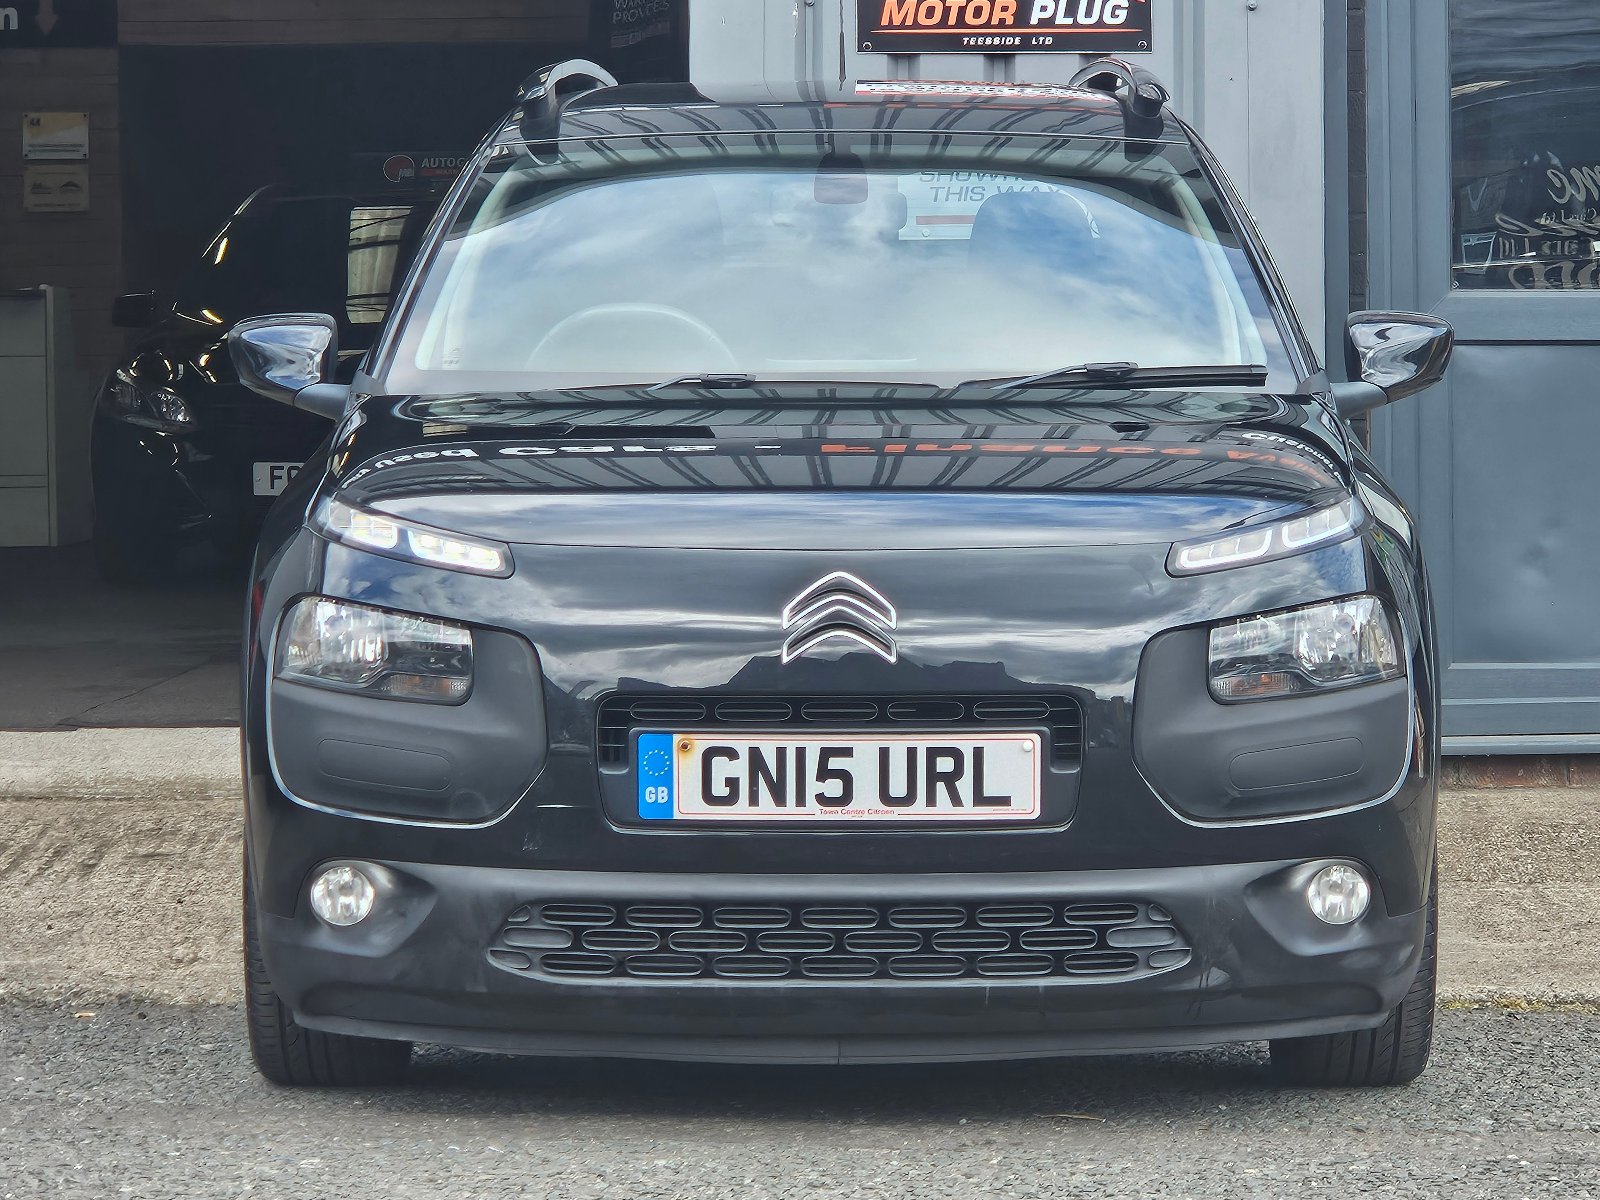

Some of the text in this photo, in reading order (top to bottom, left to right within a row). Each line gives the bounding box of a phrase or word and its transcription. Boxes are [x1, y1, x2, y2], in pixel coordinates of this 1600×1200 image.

[880, 0, 1130, 26] MOTOR PLUG
[962, 37, 1053, 46] TEESSIDE LTD
[929, 185, 986, 202] THIS
[701, 746, 1012, 807] GN15 URL
[645, 786, 669, 803] GB
